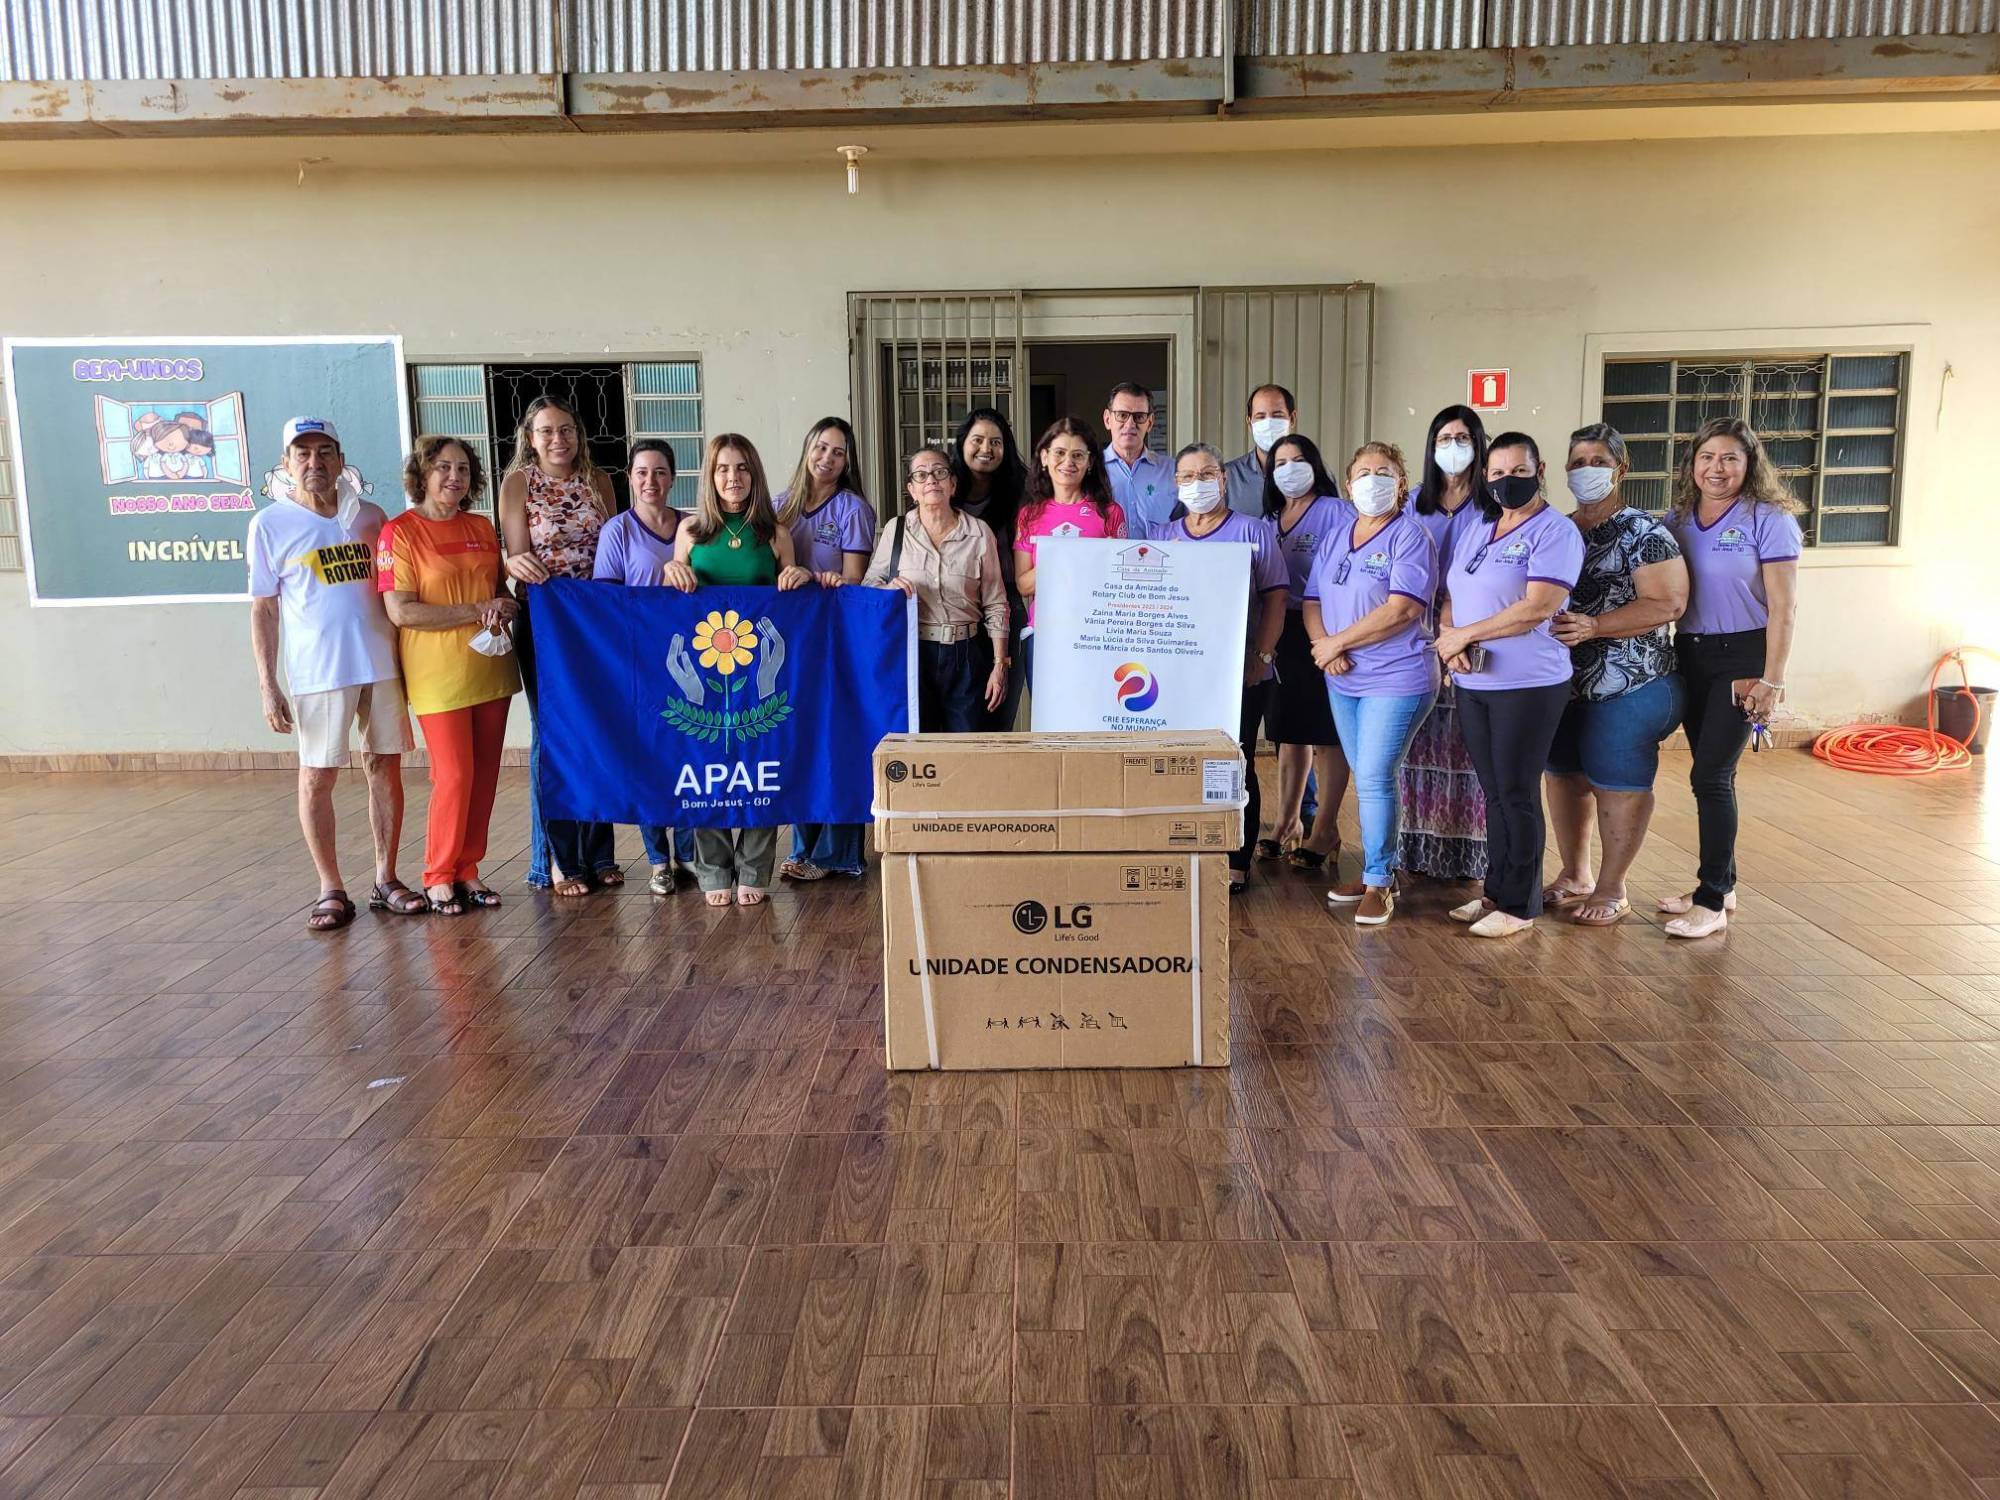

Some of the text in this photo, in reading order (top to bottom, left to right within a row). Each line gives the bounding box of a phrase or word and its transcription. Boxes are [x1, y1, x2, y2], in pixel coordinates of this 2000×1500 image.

[74, 359, 202, 380] BEM-VINDOS
[111, 489, 253, 513] NOSSO ANO SERÁ
[128, 534, 244, 560] INCRÍVEL
[318, 543, 371, 566] RANCHO
[324, 561, 372, 584] ROTARY
[1104, 582, 1122, 590] Casa
[1135, 583, 1166, 591] Amizade
[1092, 590, 1116, 600] Rotary
[1118, 591, 1135, 599] Club
[1149, 592, 1165, 600] Bom
[1167, 593, 1189, 601] Jesus
[1138, 611, 1165, 620] Borges
[1167, 612, 1188, 620] Alves
[1084, 617, 1105, 625] Vânia
[1107, 618, 1133, 626] Pereira
[1136, 620, 1163, 629] Borges
[1176, 621, 1195, 629] Silva
[1149, 629, 1172, 637] Souza
[1080, 634, 1100, 642] Maria
[1103, 635, 1123, 643] Lúcia
[1136, 637, 1155, 645] Silva
[1157, 638, 1198, 647] Guimarães
[1073, 642, 1204, 656] Simone Márcia dos Santos Oliveira
[1102, 715, 1167, 726] CRIE ESPERANÇA
[912, 764, 937, 779] LG
[674, 761, 781, 796] APAE
[682, 799, 708, 809] Bom
[753, 797, 771, 807] GO
[912, 823, 1056, 833] UNIDADE EVAPORADORA
[1054, 905, 1092, 929] LG
[1054, 933, 1099, 941] Life's Good
[909, 956, 1203, 976] UNIDADE CONDENSADORA
